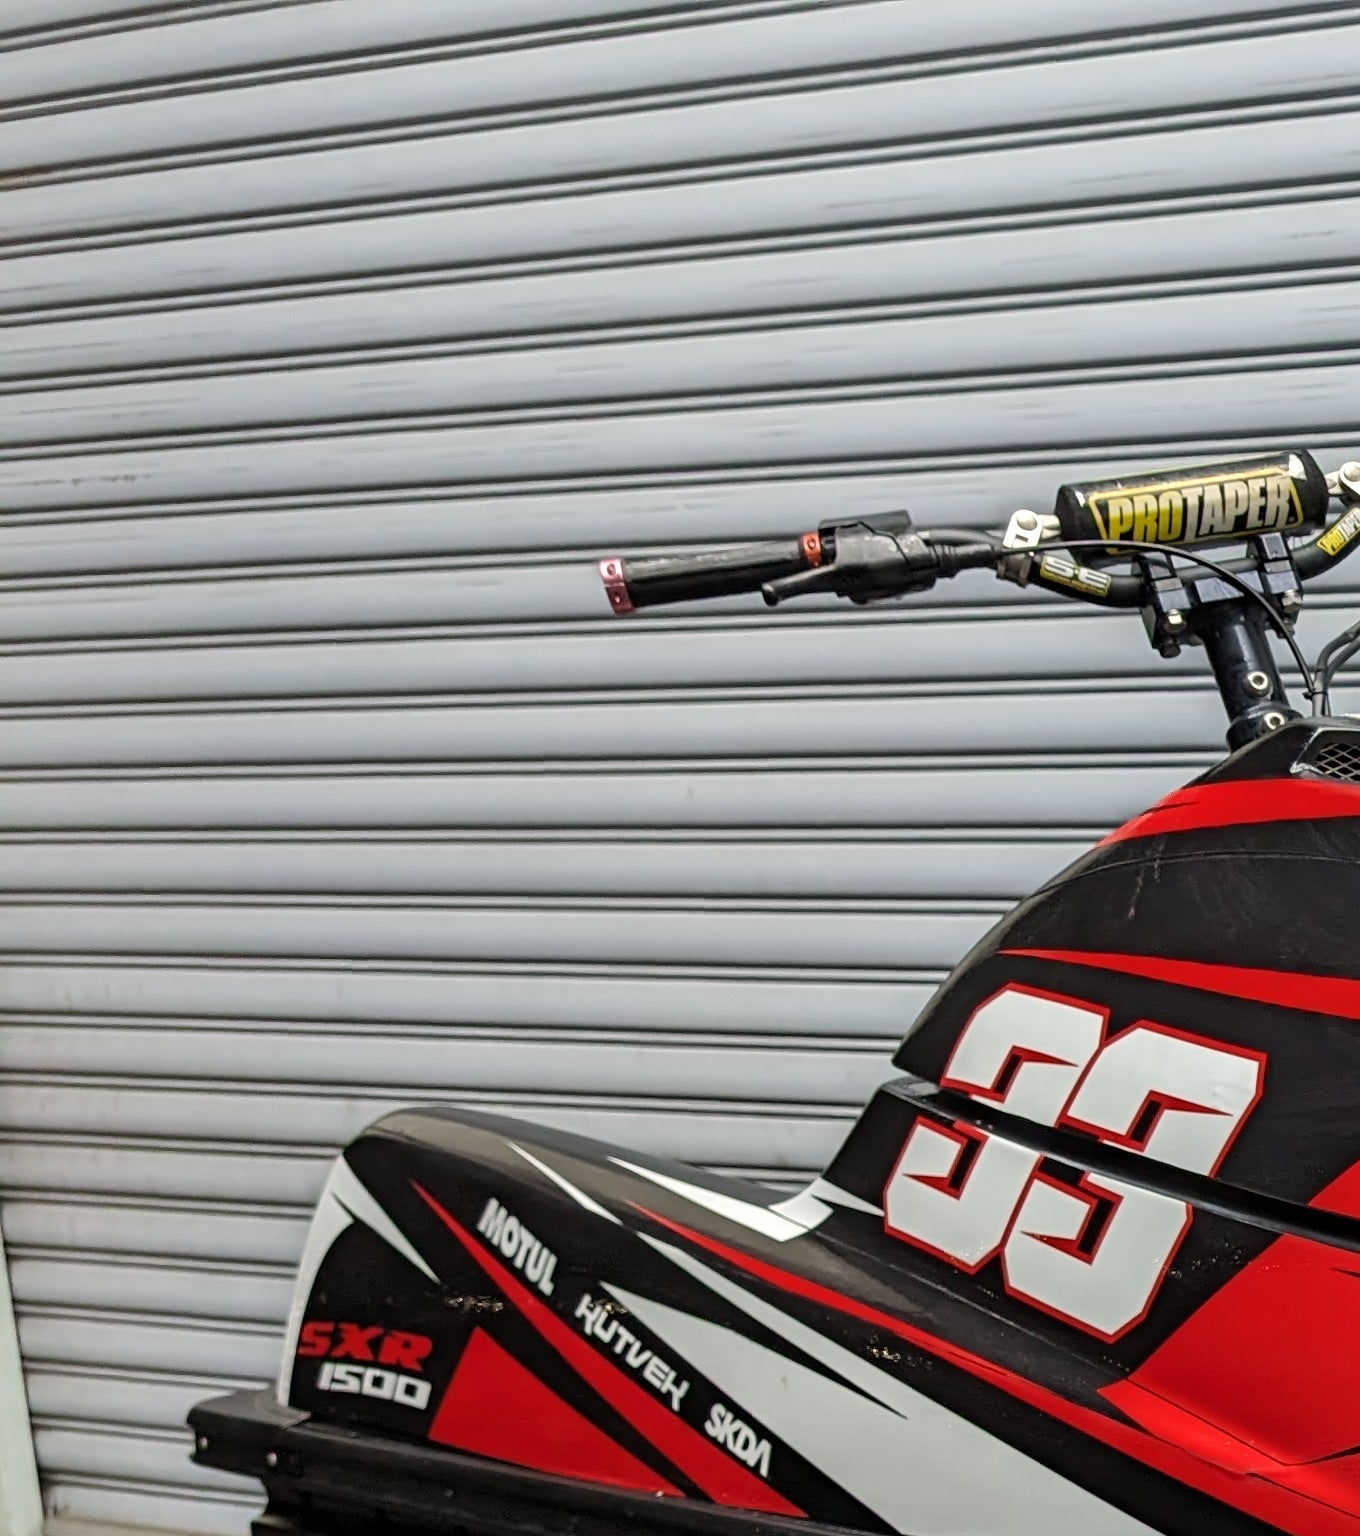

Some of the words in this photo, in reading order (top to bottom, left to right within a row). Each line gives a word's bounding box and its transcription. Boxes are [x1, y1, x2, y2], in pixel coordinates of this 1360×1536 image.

[1107, 474, 1294, 543] PROTAPER
[476, 1197, 558, 1296] MOTUL
[299, 1320, 433, 1372] SXR
[316, 1361, 433, 1411] 1500
